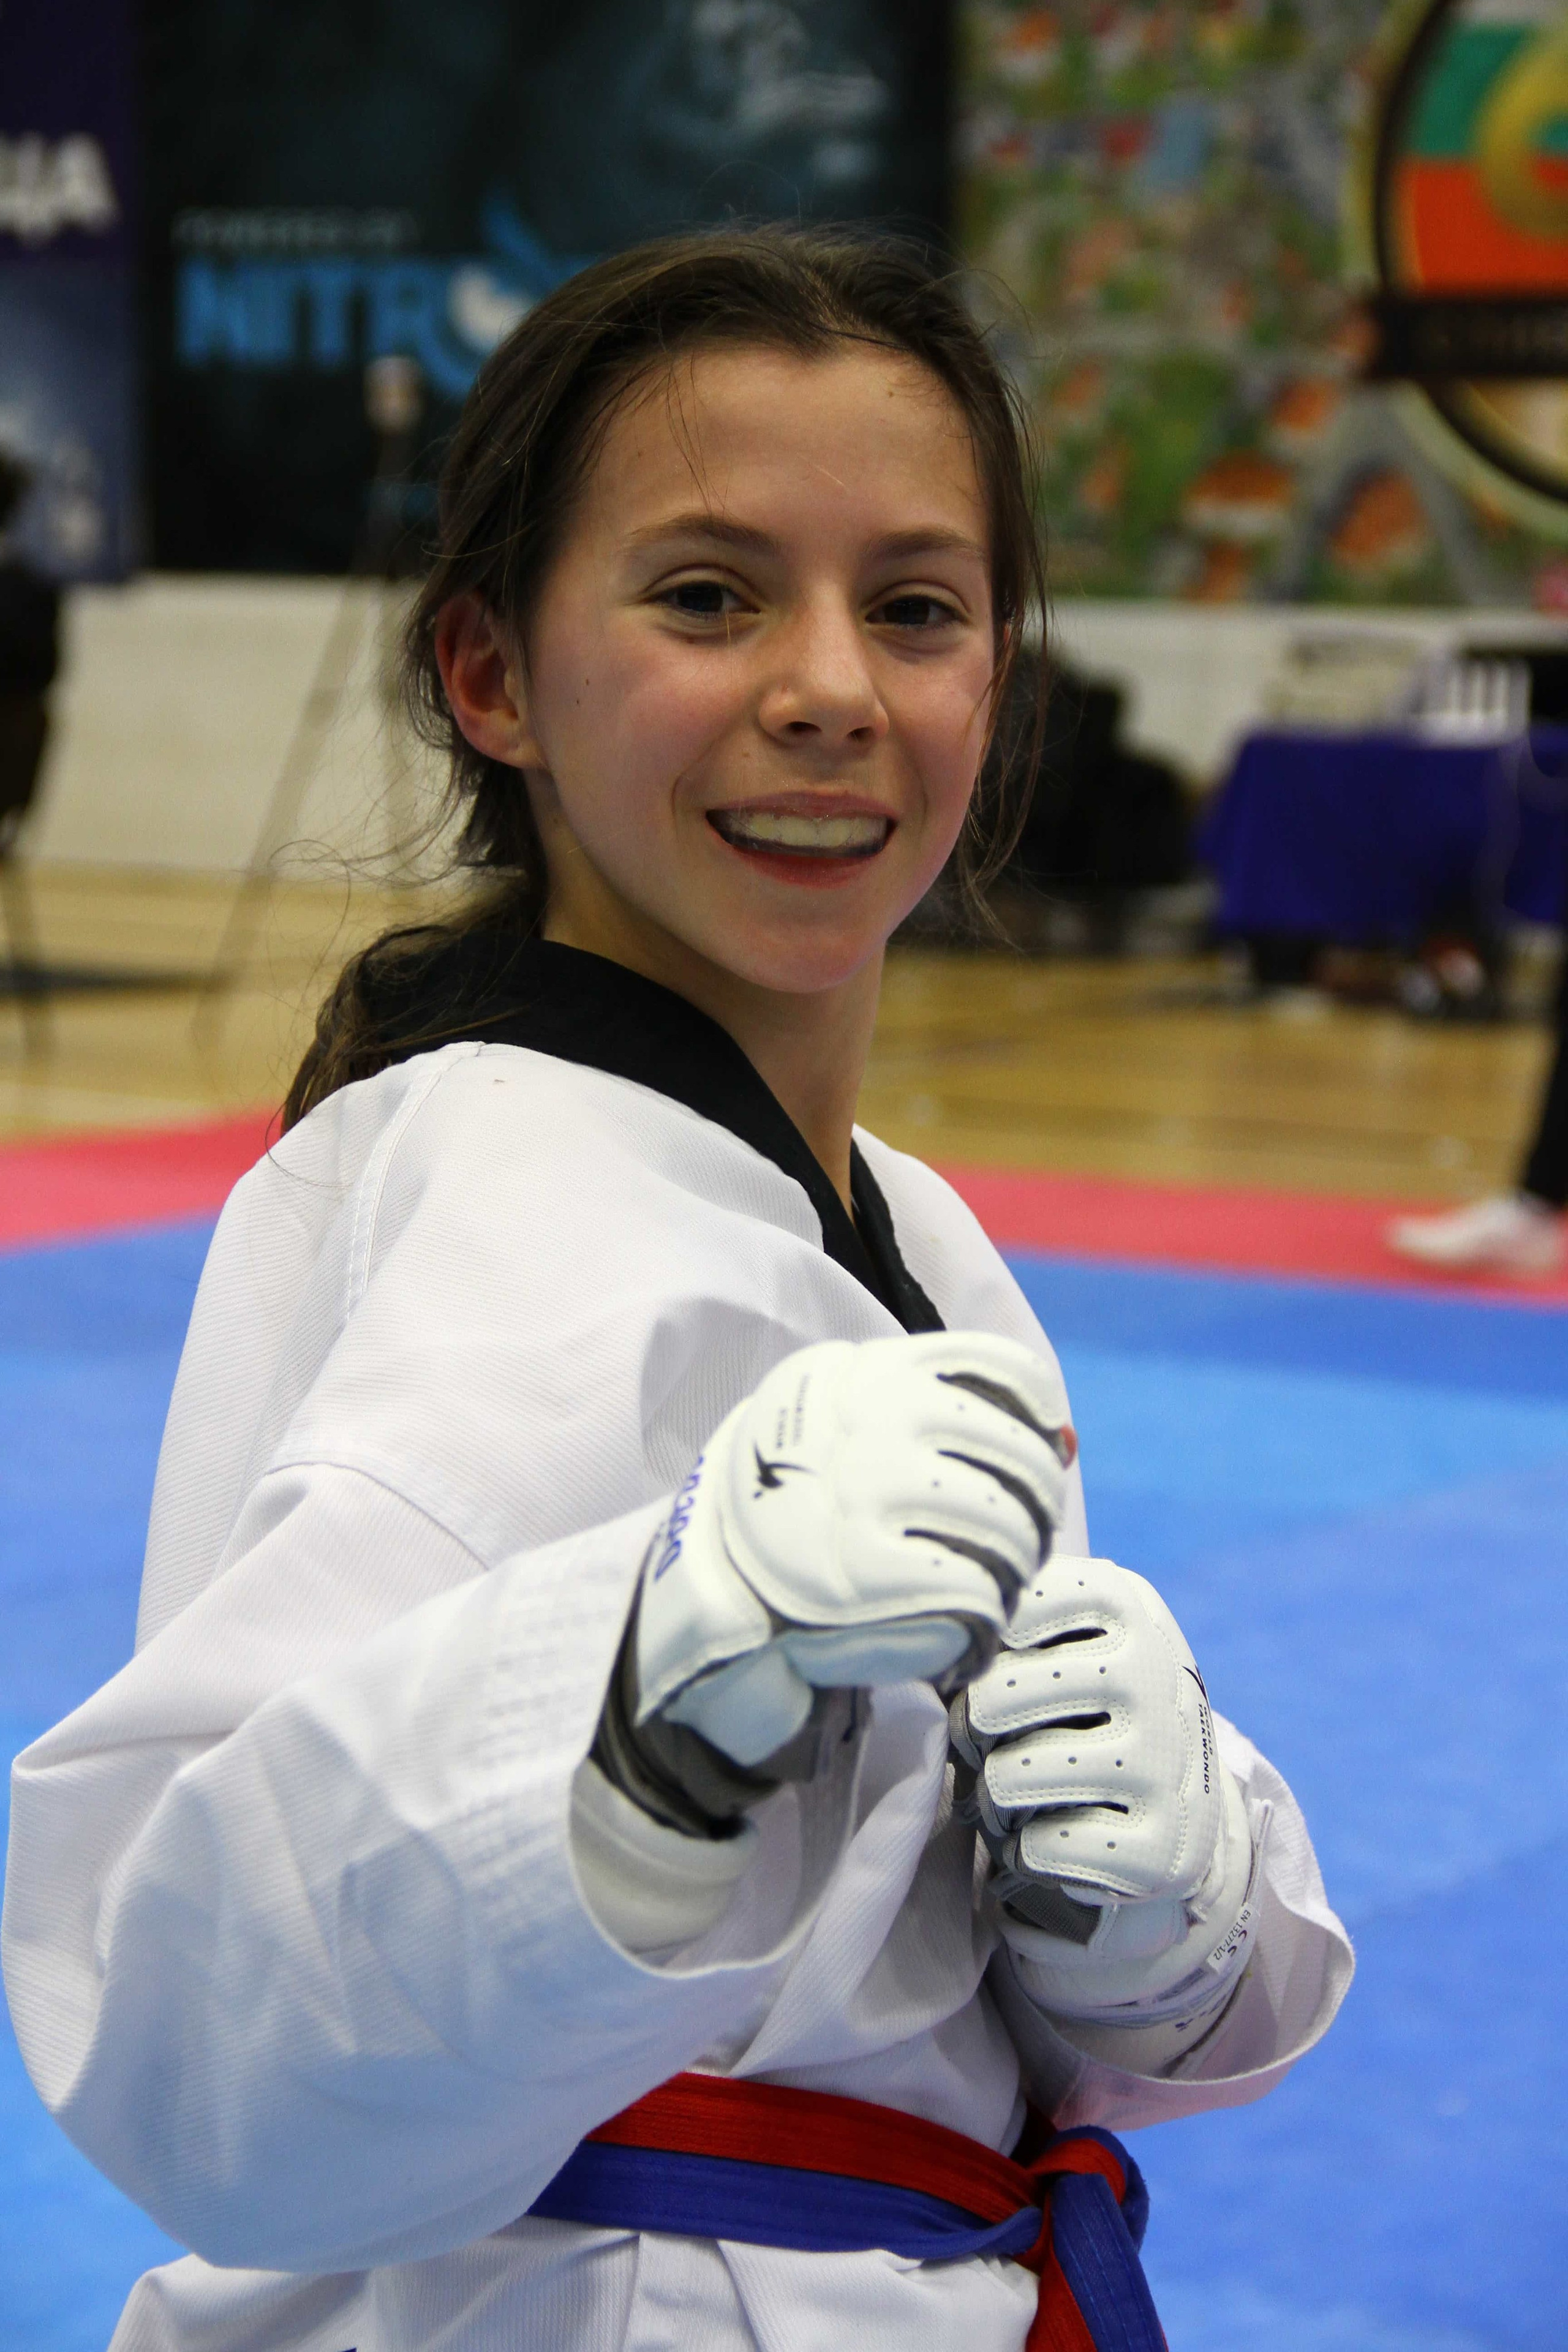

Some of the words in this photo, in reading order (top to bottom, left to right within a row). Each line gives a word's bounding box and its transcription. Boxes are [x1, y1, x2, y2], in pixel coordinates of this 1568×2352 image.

[1198, 1703, 1210, 1795] TAEKWONDO
[1204, 1706, 1213, 1756] WORLD
[1240, 1909, 1251, 1923] EN
[1213, 1921, 1243, 1961] 13277-1/2
